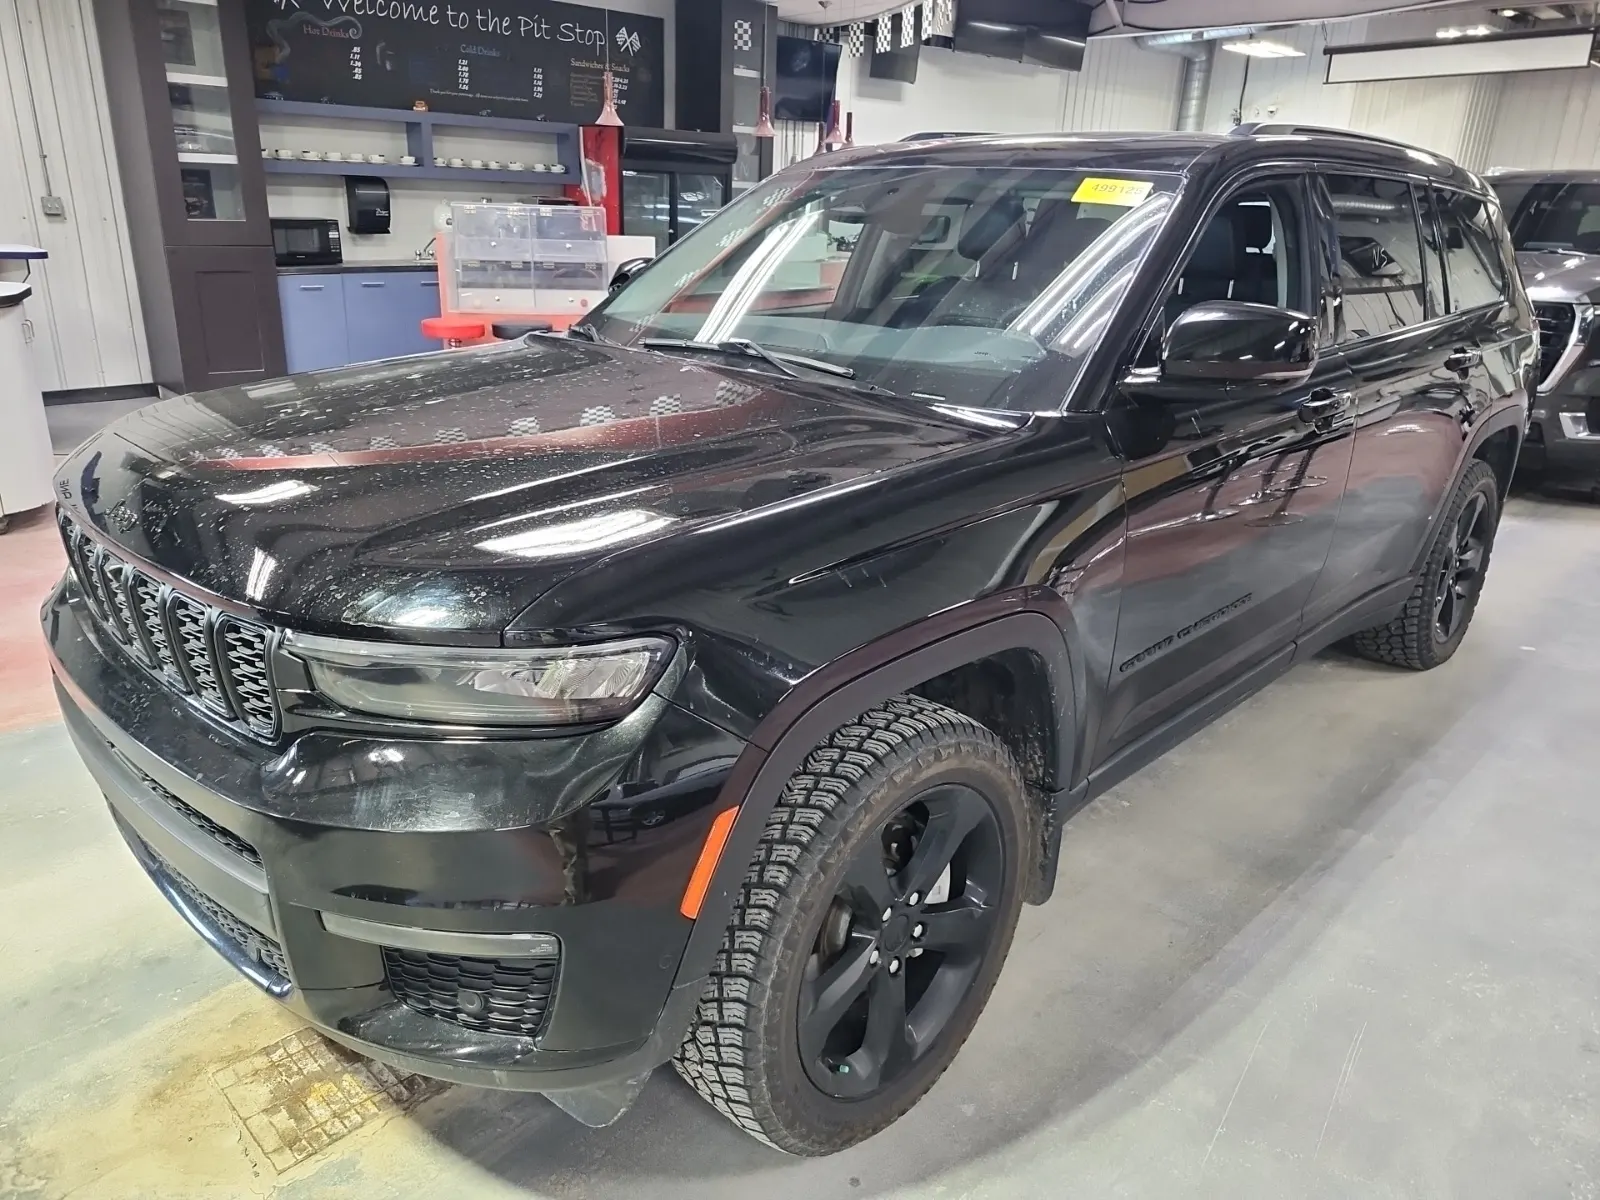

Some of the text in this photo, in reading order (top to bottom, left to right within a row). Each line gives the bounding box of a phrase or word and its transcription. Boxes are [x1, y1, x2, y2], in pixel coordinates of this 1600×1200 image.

[302, 23, 350, 39] Hot Drinks
[446, 5, 470, 30] to
[476, 8, 512, 36] the
[517, 14, 551, 40] Pit
[556, 23, 606, 56] Stop
[460, 44, 501, 57] Cold Drinks
[570, 58, 604, 69] Sandwiches
[611, 63, 630, 72] Snacks
